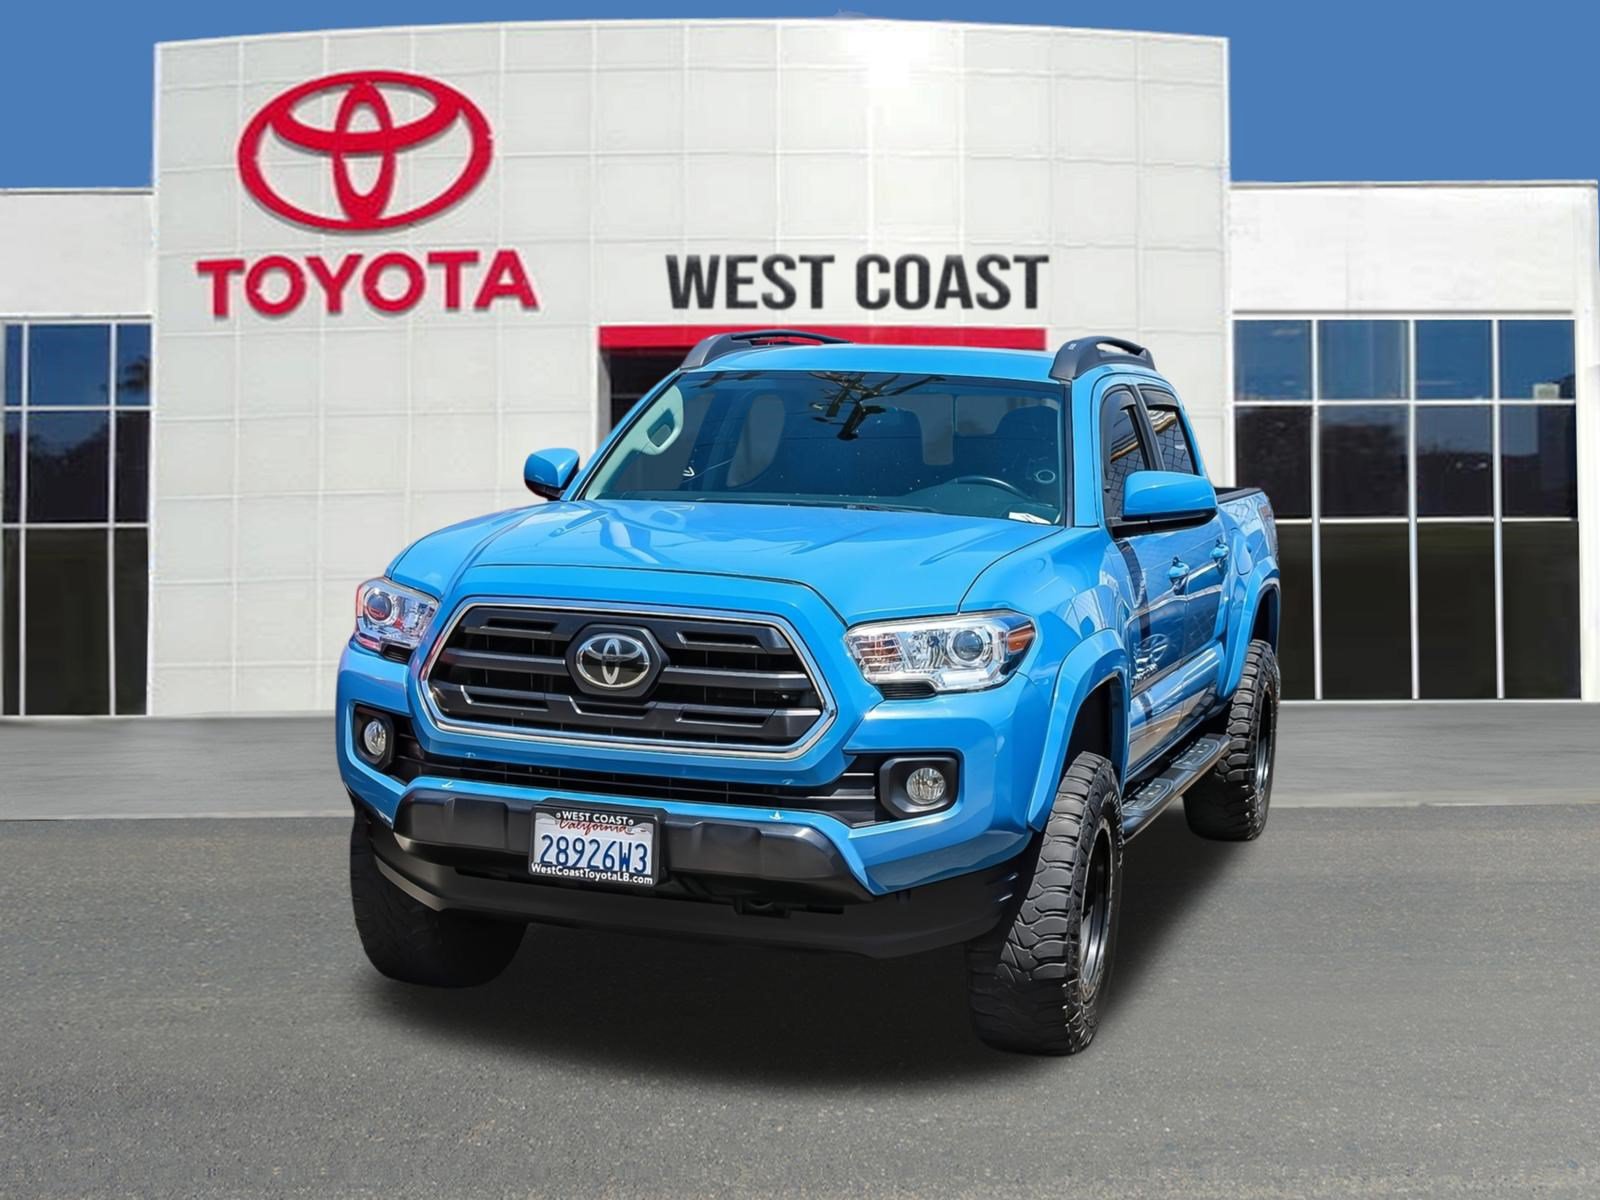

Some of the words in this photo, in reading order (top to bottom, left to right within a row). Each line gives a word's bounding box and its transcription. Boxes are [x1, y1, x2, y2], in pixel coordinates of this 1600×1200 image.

[196, 249, 540, 317] TOYOTA
[665, 254, 835, 310] WEST
[855, 254, 1050, 310] COAST
[562, 810, 591, 822] WEST
[592, 813, 629, 825] COAST
[531, 862, 653, 885] WestCoastToyotaLB.com
[539, 834, 649, 876] 28926W3
